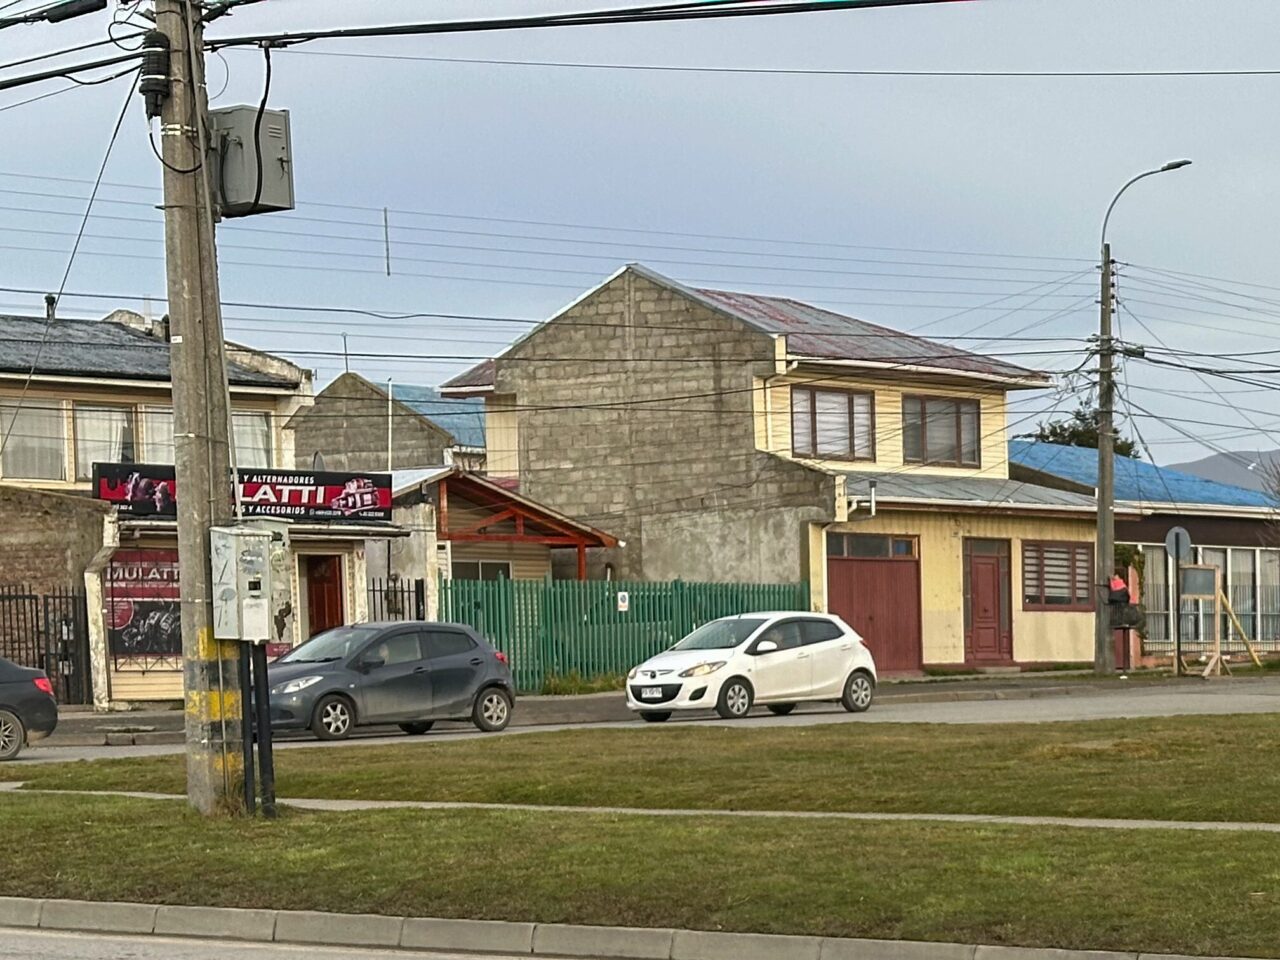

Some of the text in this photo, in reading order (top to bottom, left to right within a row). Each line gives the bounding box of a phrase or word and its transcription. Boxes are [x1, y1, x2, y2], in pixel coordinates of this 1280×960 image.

[243, 474, 250, 482] Y
[252, 474, 315, 485] ALTERNADORES
[231, 484, 324, 504] LATTI
[255, 506, 305, 515] ACCESORIOS
